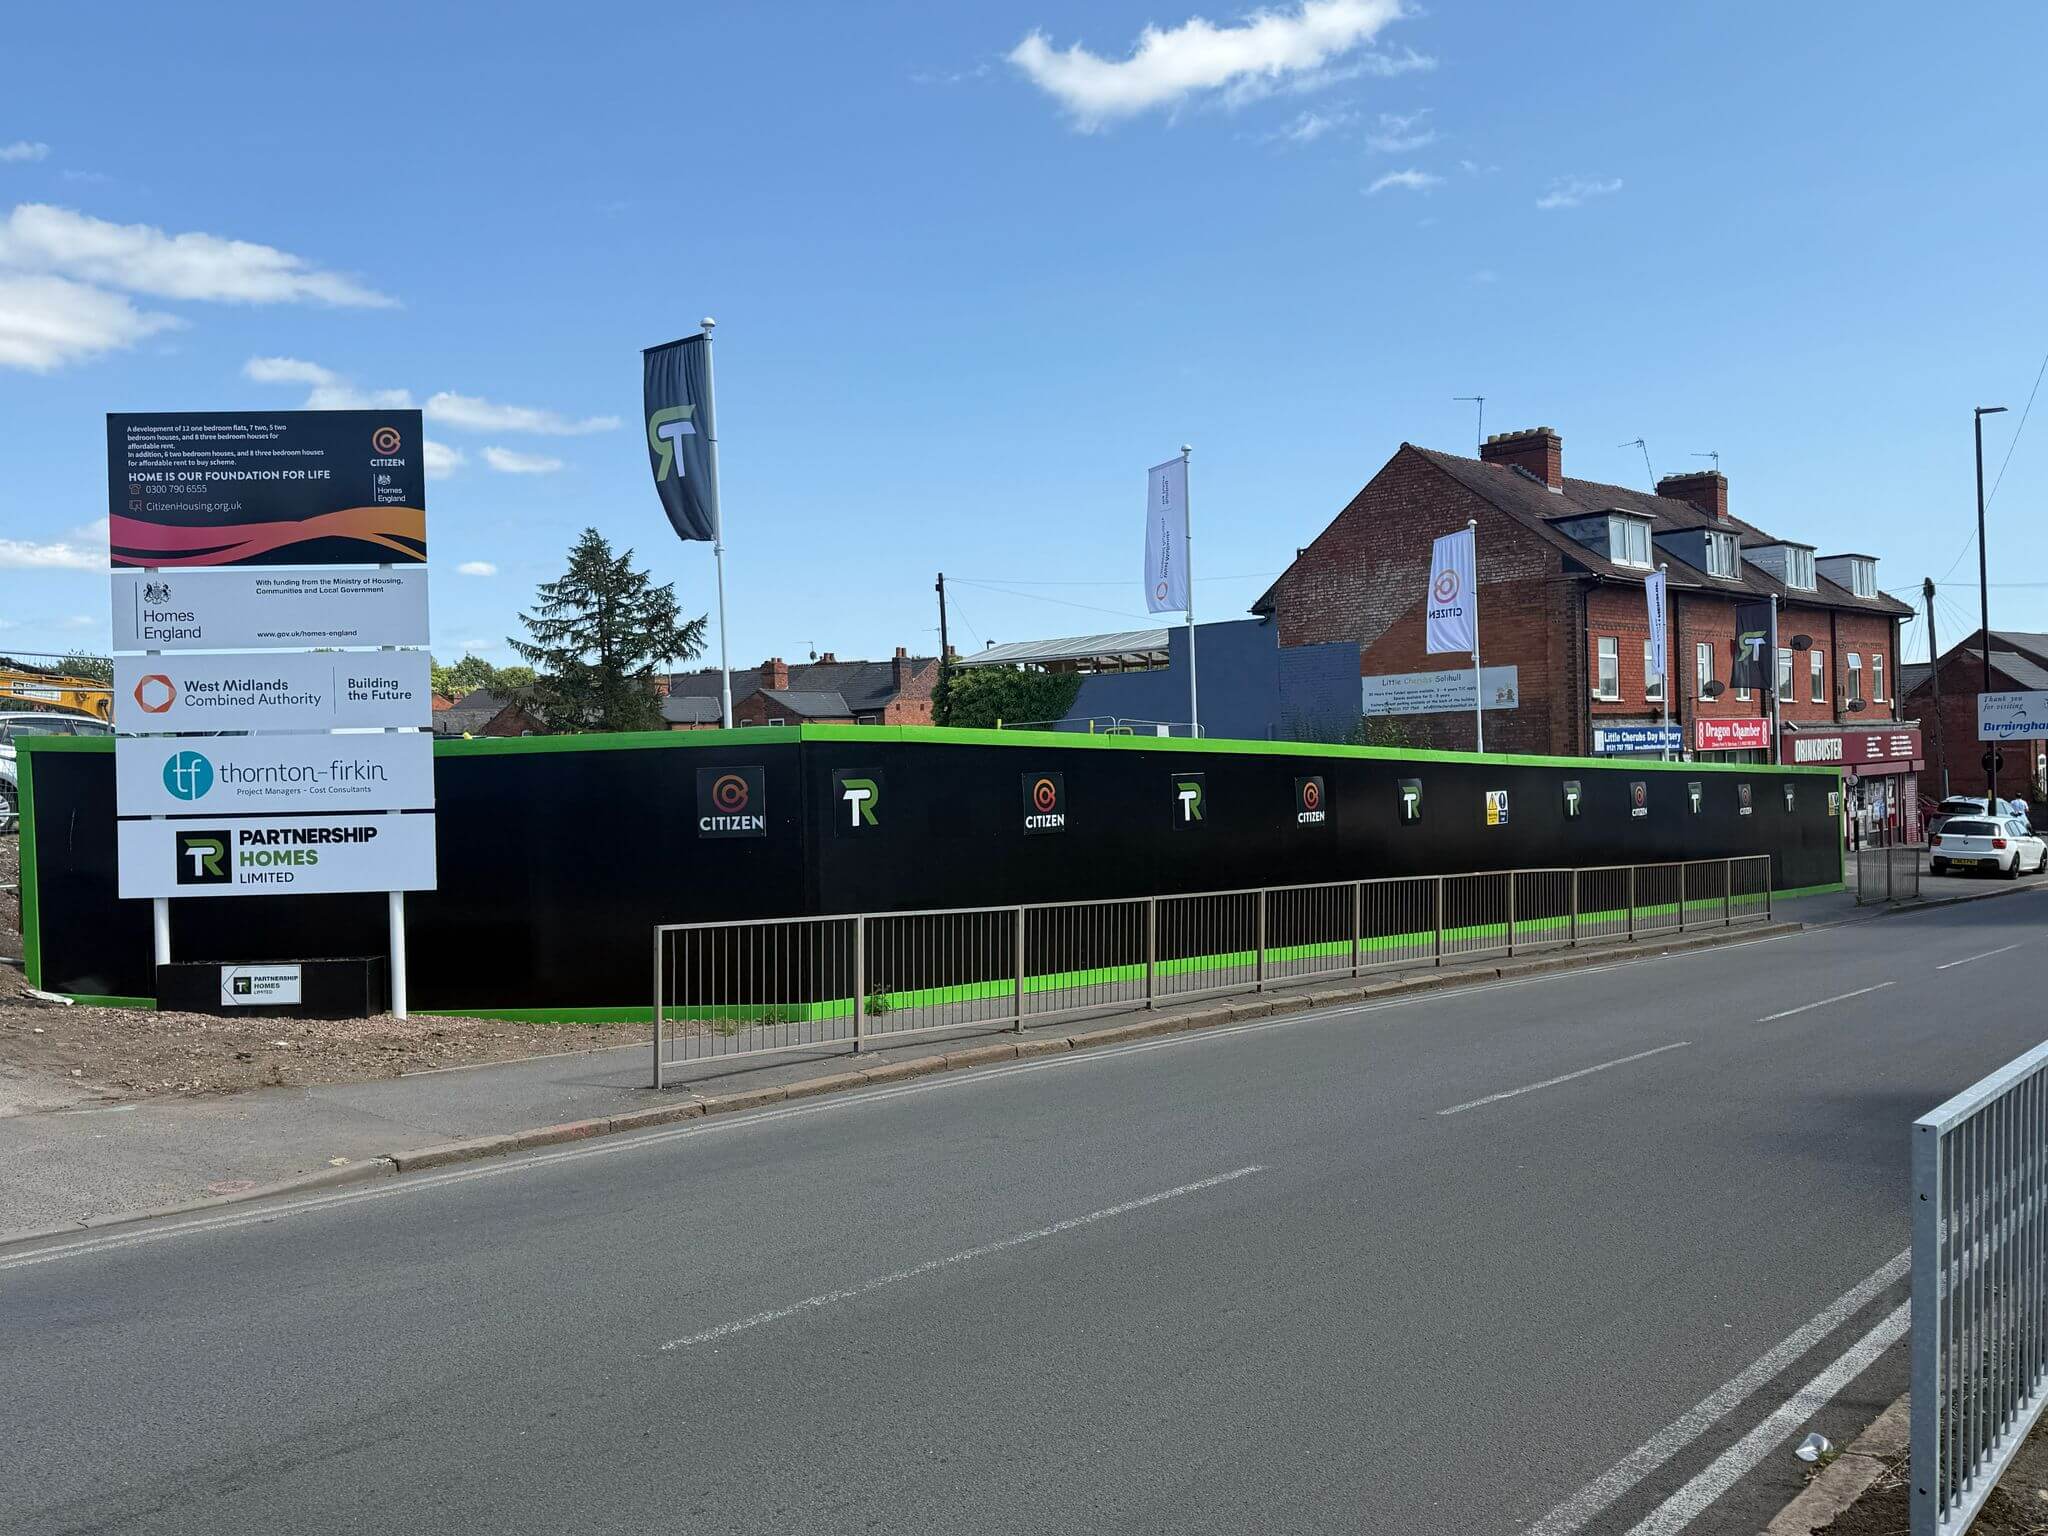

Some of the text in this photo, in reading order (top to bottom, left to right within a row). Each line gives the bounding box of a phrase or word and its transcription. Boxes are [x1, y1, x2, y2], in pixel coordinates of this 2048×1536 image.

[157, 434, 181, 442] houses,
[210, 458, 236, 466] scheme.
[370, 459, 405, 467] CITIZEN
[128, 470, 330, 481] HOME IS OUR FOUNDATION FOR LIFE
[146, 484, 207, 494] 0300 790 6555
[378, 495, 406, 503] England
[146, 501, 242, 512] CitizenHousing.org.uk
[333, 578, 361, 586] Ministry
[340, 586, 384, 594] Government
[144, 610, 195, 622] Homes
[145, 626, 201, 642] England
[257, 630, 358, 638] www.gov.uk/homes-england
[348, 678, 398, 688] Building
[1435, 674, 1461, 682] Solihull
[184, 679, 288, 692] West Midlands
[185, 692, 322, 706] Combined Authority
[349, 690, 412, 700] the Future
[1983, 702, 2024, 712] for visiting
[1706, 722, 1760, 741] Dragon Chamber
[1984, 722, 2048, 732] Birmingha
[1604, 732, 1620, 742] Little
[1622, 732, 1646, 742] Cherubs
[1646, 731, 1658, 743] Day
[1795, 738, 1842, 762] DRINKBUSTER
[220, 759, 388, 783] thornton-firkin
[236, 788, 262, 796] Project
[265, 786, 300, 796] Managers
[310, 786, 326, 794] Cost
[328, 785, 372, 794] Consultants
[700, 816, 764, 830] CITIZEN
[1026, 814, 1064, 828] CITIZEN
[1298, 811, 1324, 824] CITIZEN
[240, 827, 378, 846] PARTNERSHIP
[240, 850, 318, 866] HOMES
[240, 872, 294, 884] LIMITED
